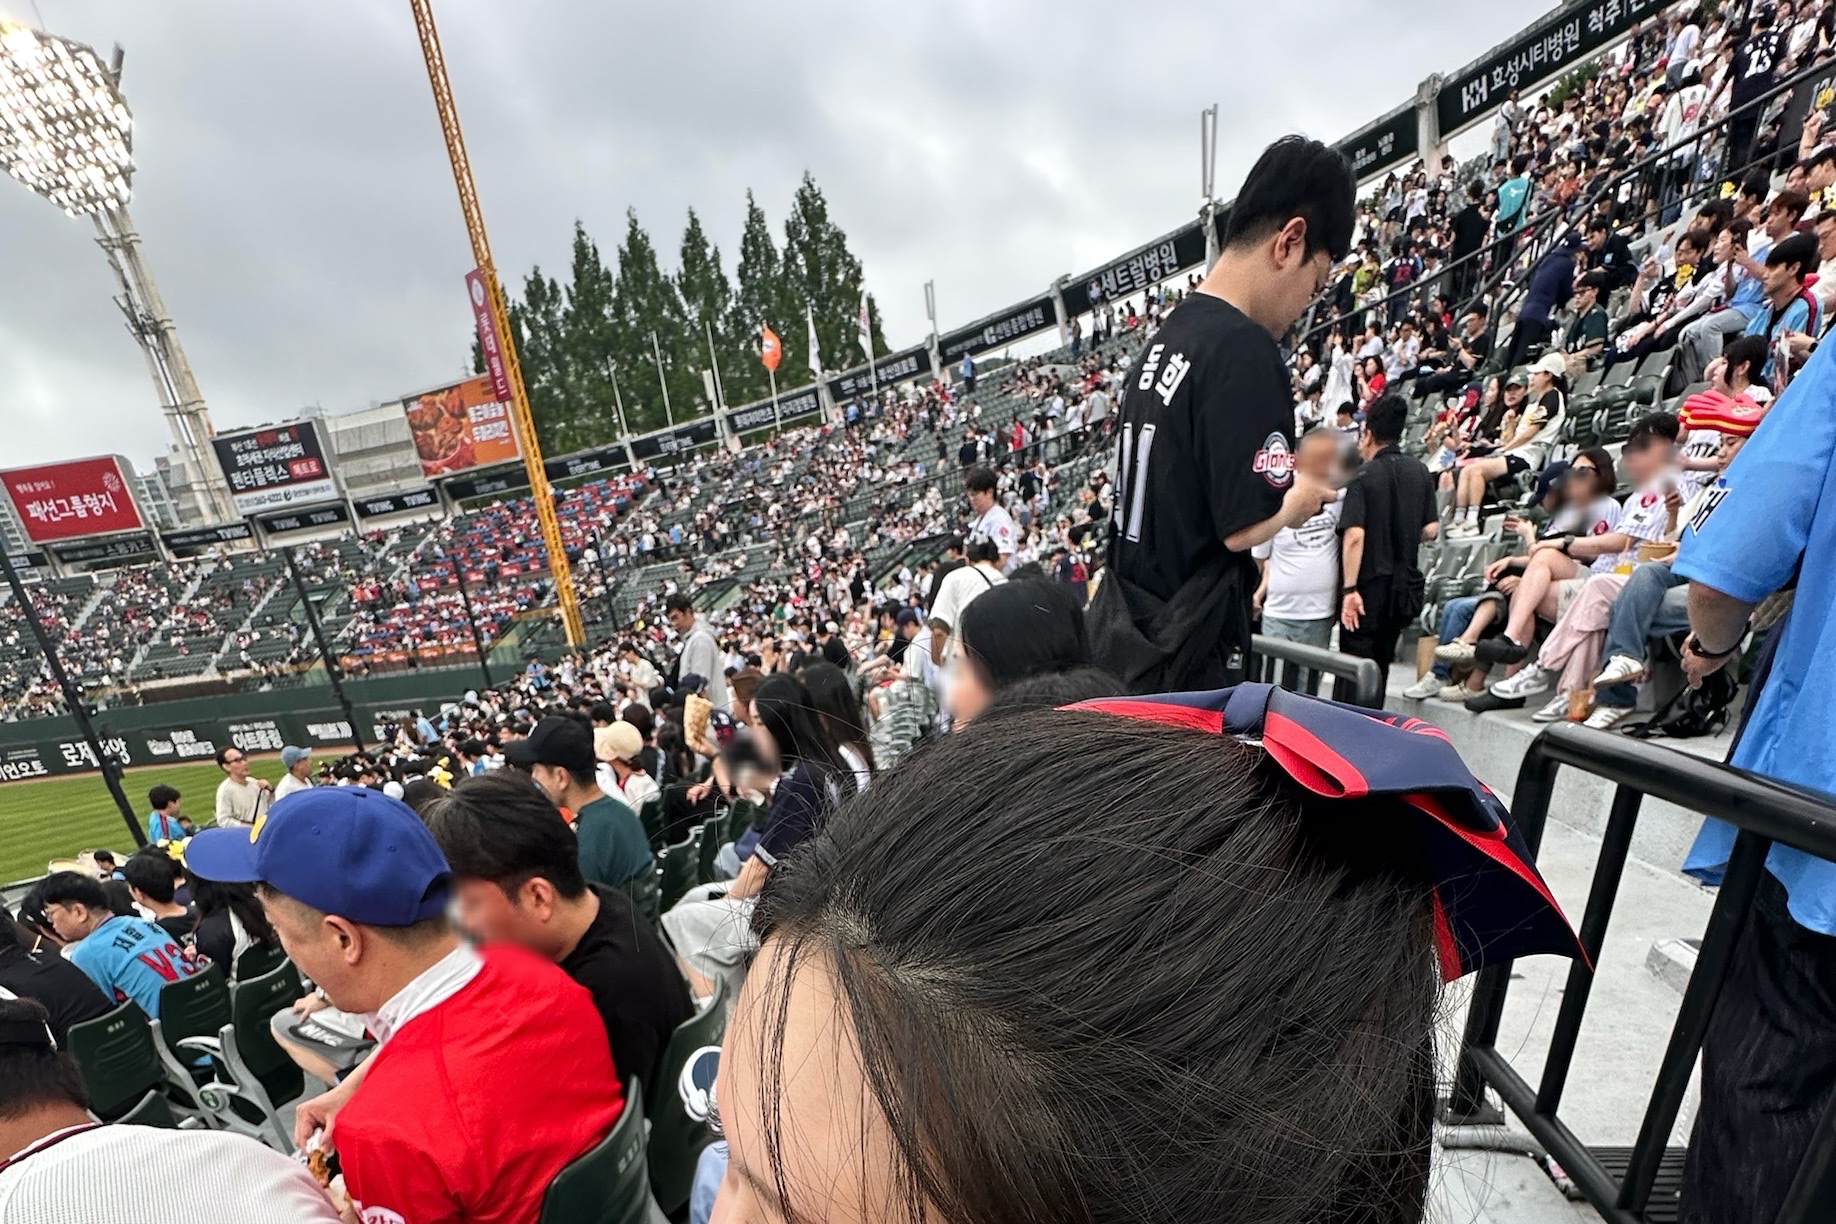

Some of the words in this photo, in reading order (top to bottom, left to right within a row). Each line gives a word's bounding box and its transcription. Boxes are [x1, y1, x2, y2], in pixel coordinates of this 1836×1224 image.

[1490, 18, 1580, 91] 효성시티병원
[1744, 49, 1772, 79] 13
[1101, 240, 1179, 300] 센트럴병원
[230, 463, 290, 490] 펜타플렉스
[26, 490, 118, 522] 패션그룹형지
[366, 499, 395, 514] TVING
[402, 492, 432, 507] TVING
[310, 510, 339, 525] TVING
[216, 526, 250, 541] TVING
